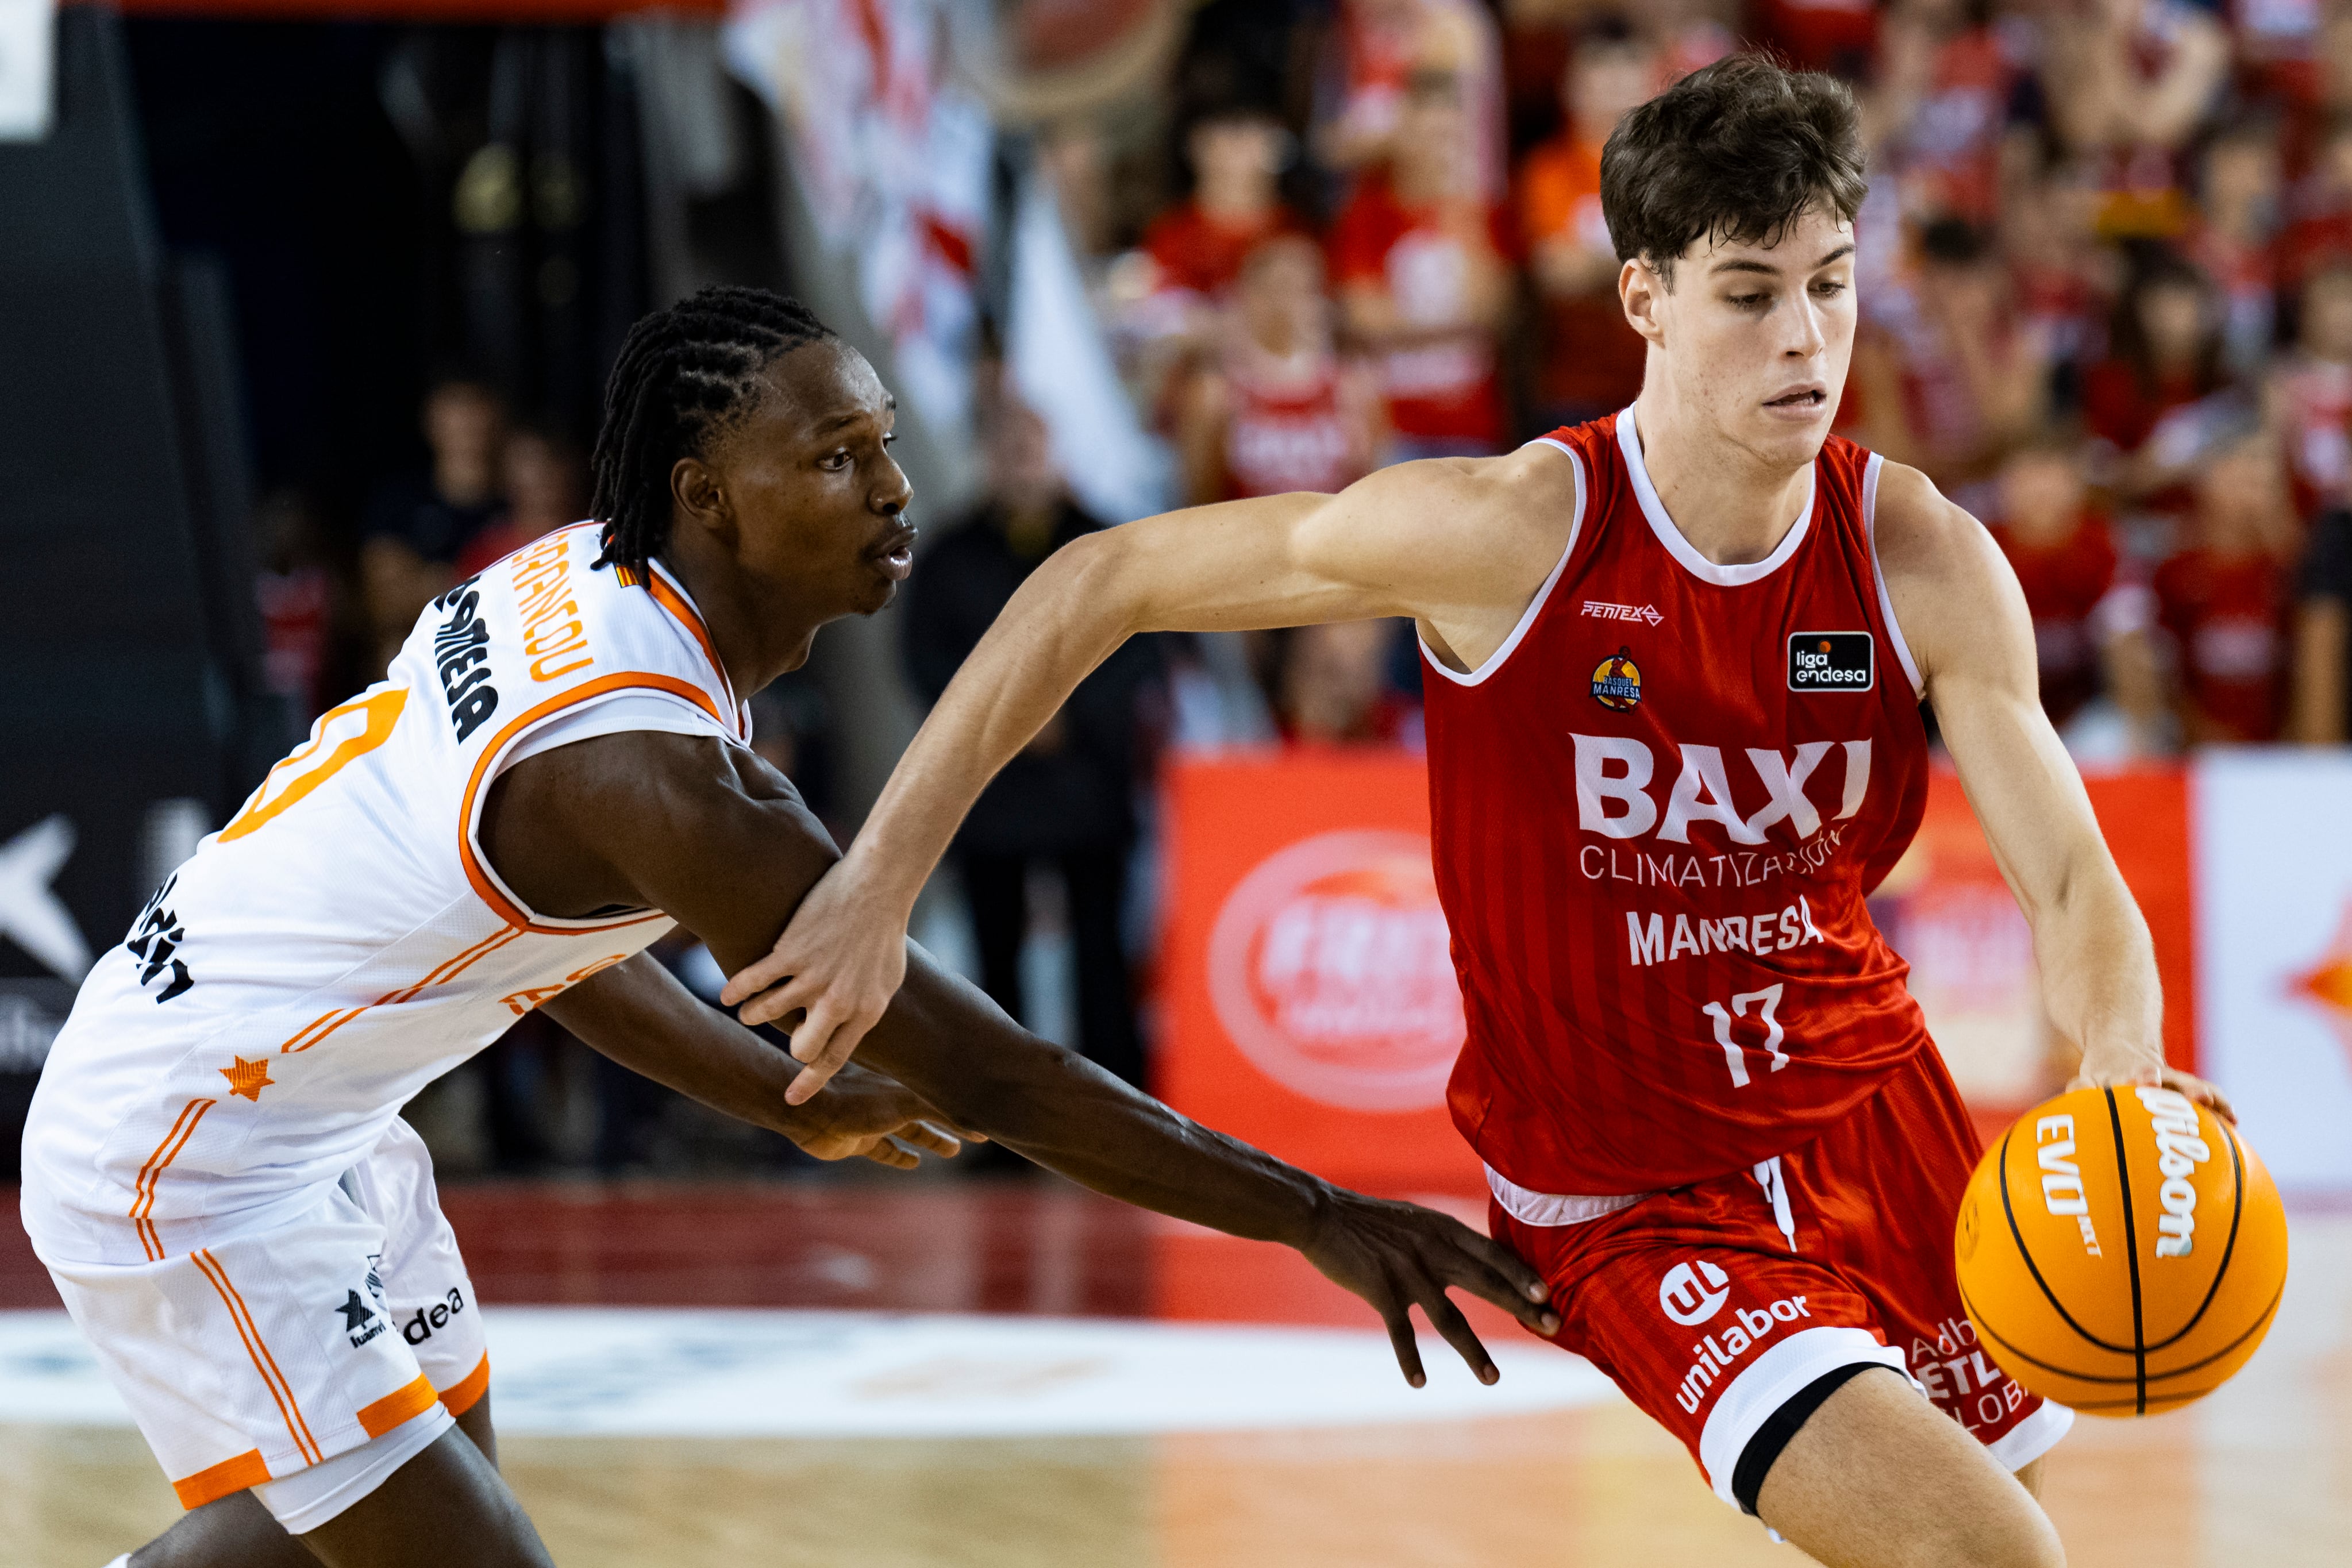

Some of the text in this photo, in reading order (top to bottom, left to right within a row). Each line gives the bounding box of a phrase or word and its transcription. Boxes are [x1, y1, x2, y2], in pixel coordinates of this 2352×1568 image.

[1581, 600, 1643, 622] PENTEX
[1593, 683, 1641, 700] MANRESA
[1796, 650, 1828, 668] liga
[1796, 666, 1866, 683] endesa
[1568, 733, 1872, 845] BAXI
[1626, 894, 1825, 966] MANRESA
[1703, 983, 1790, 1088] 17
[2037, 1114, 2088, 1216] EVO
[1676, 1295, 1811, 1415] unilabor
